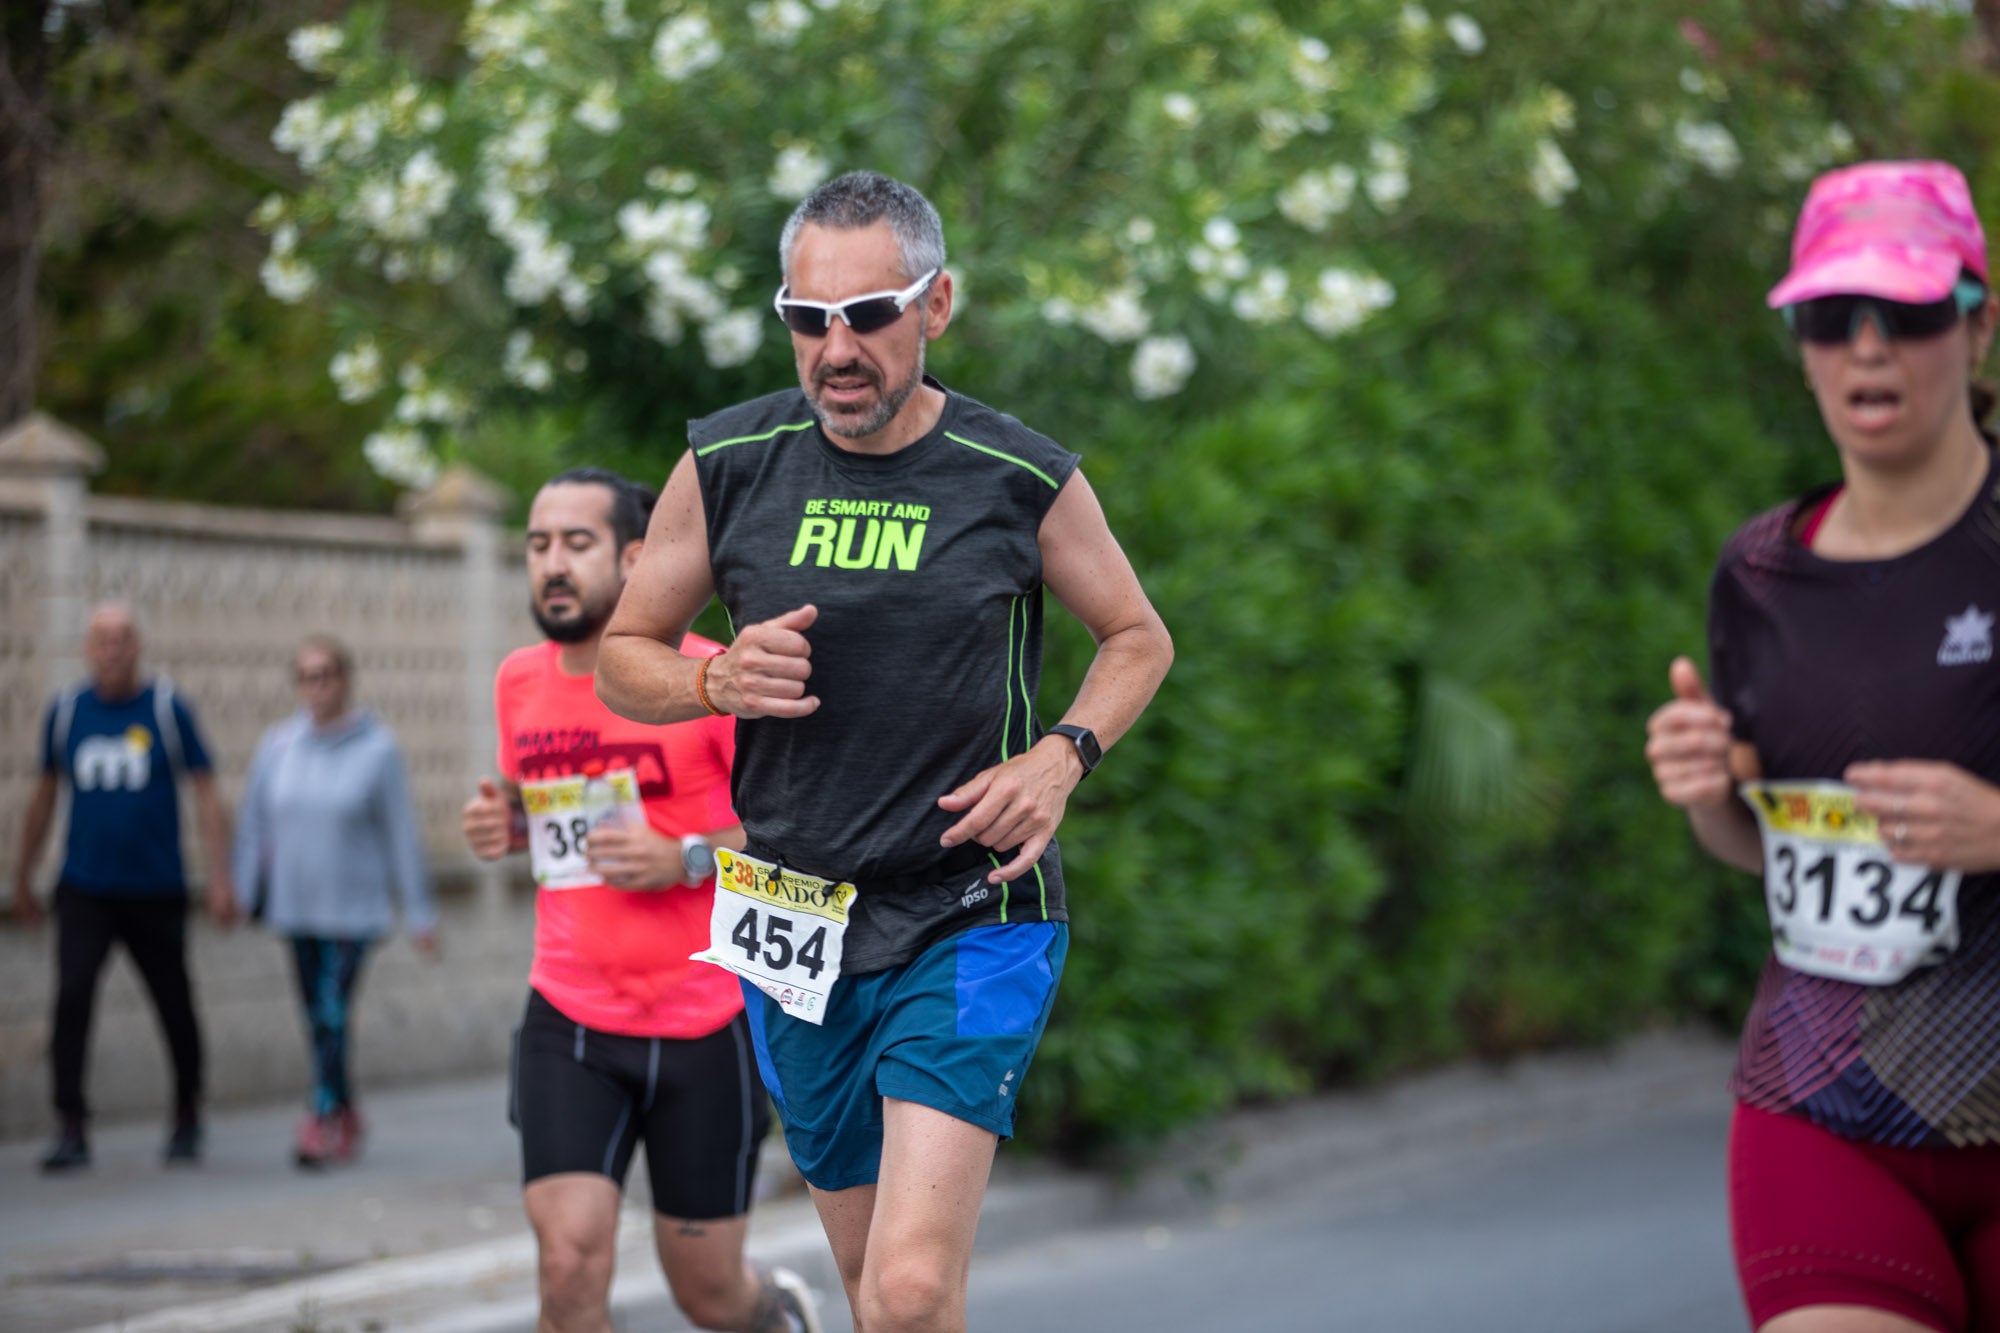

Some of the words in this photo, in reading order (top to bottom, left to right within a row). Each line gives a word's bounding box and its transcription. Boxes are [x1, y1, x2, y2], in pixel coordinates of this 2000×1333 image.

[805, 499, 828, 515] BE
[828, 499, 892, 517] SMART
[892, 503, 931, 522] AND
[789, 517, 927, 571] RUN
[735, 861, 754, 887] 38
[754, 874, 828, 908] FONDO
[1776, 846, 1942, 934] 3134
[732, 907, 826, 980] 454
